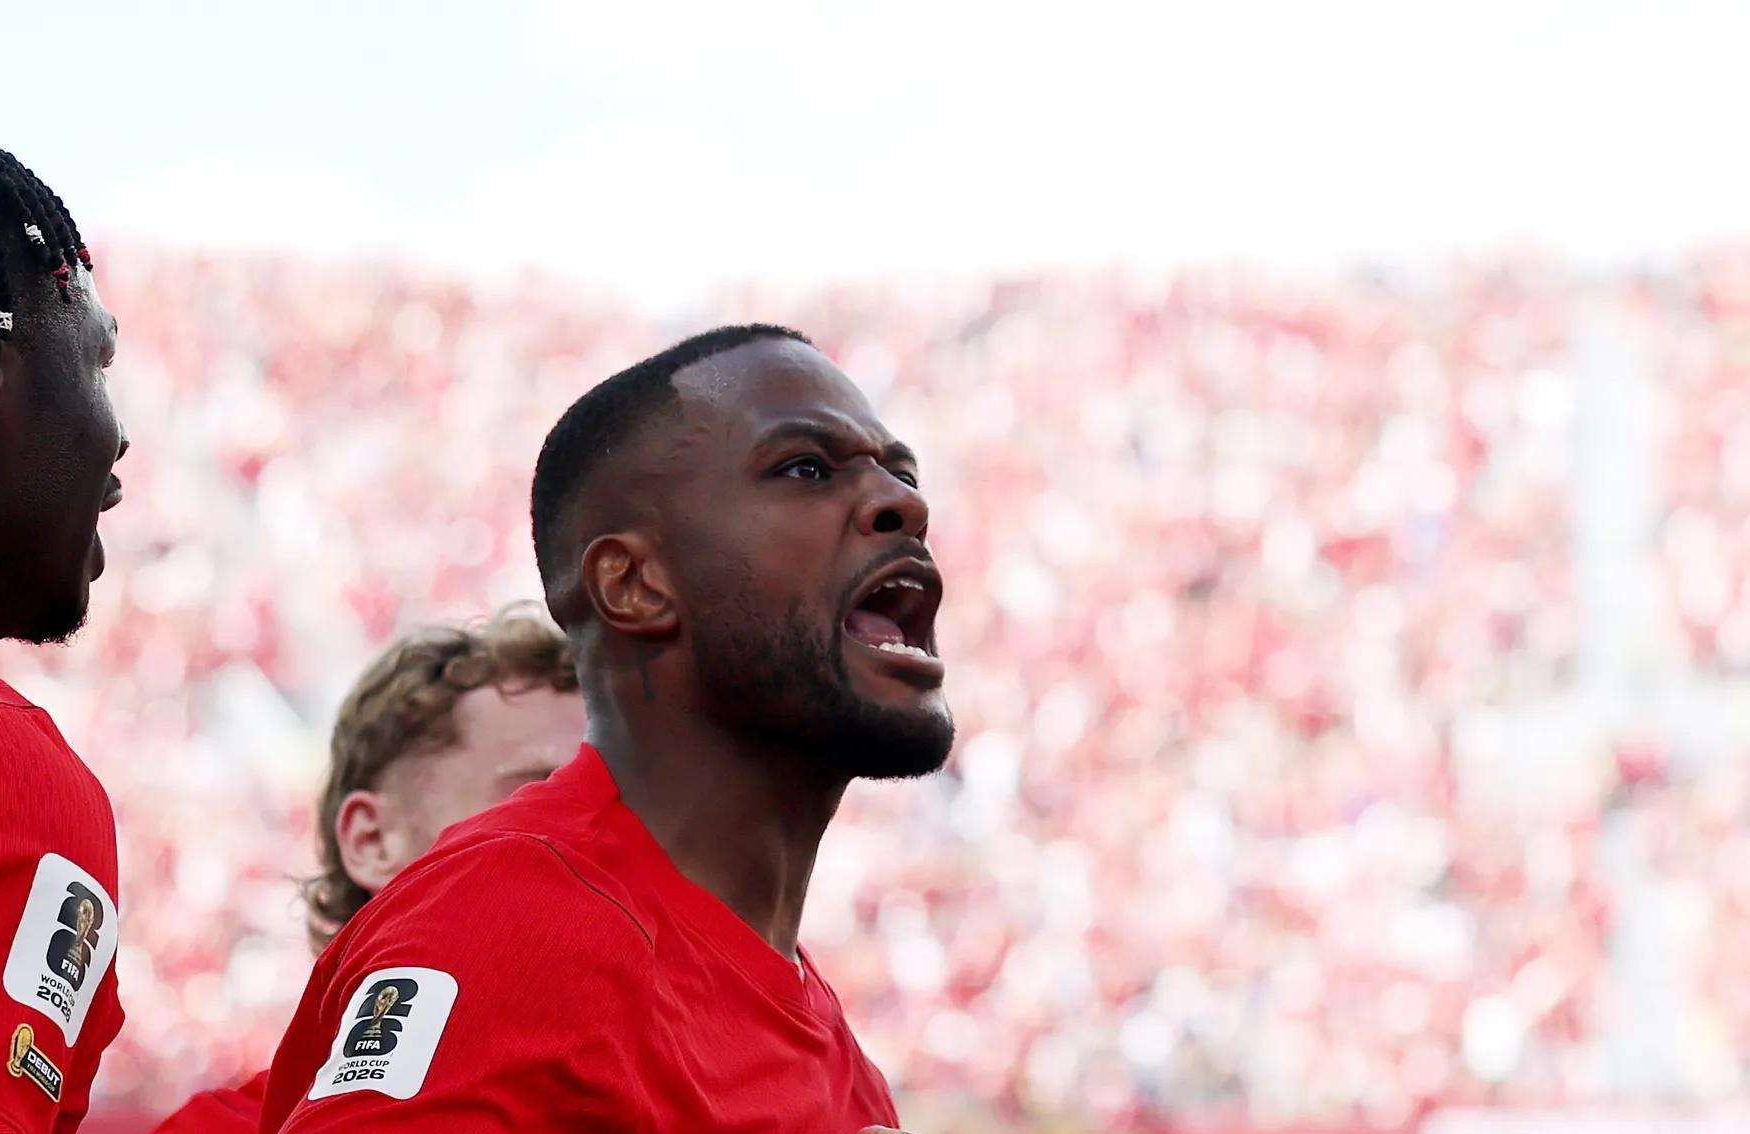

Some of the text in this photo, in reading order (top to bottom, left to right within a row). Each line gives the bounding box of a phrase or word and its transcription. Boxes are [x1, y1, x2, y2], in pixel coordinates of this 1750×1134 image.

[61, 959, 79, 981] FIFA
[355, 1040, 380, 1050] FIFA
[27, 1051, 60, 1085] DEBUT
[332, 1068, 386, 1085] 2026
